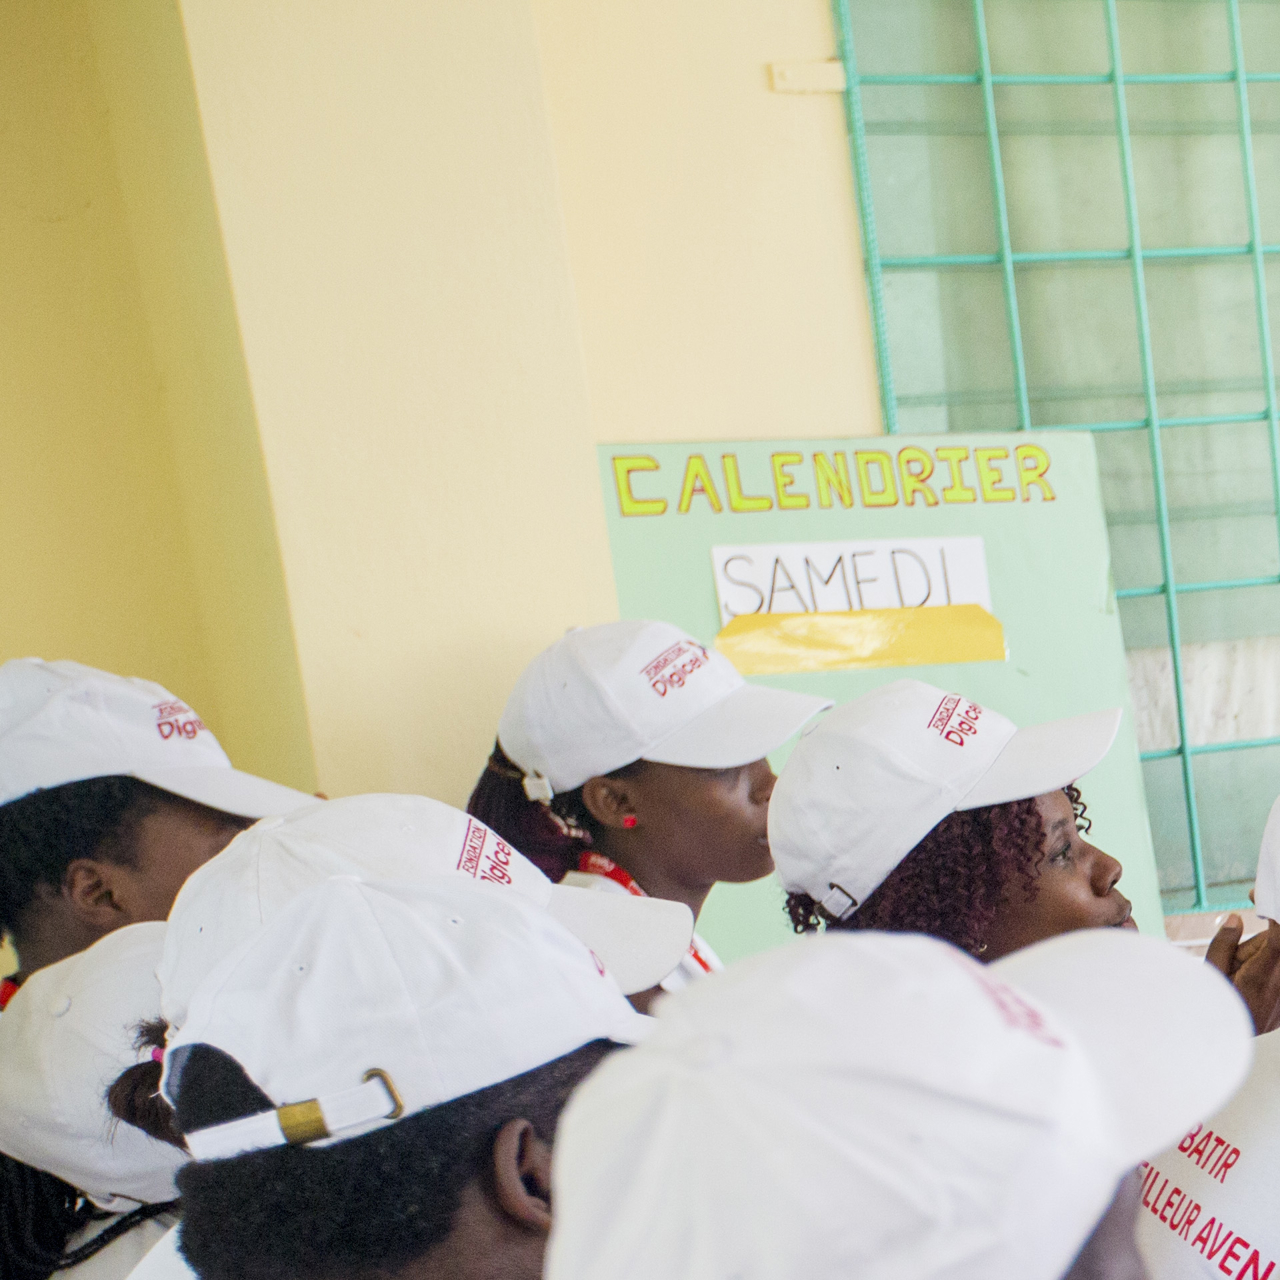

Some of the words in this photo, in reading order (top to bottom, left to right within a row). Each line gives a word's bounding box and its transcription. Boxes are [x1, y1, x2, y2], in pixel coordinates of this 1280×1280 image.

[612, 444, 1056, 517] CALENDRIER
[722, 547, 951, 617] SAMEDI
[1178, 1122, 1241, 1184] BATIR
